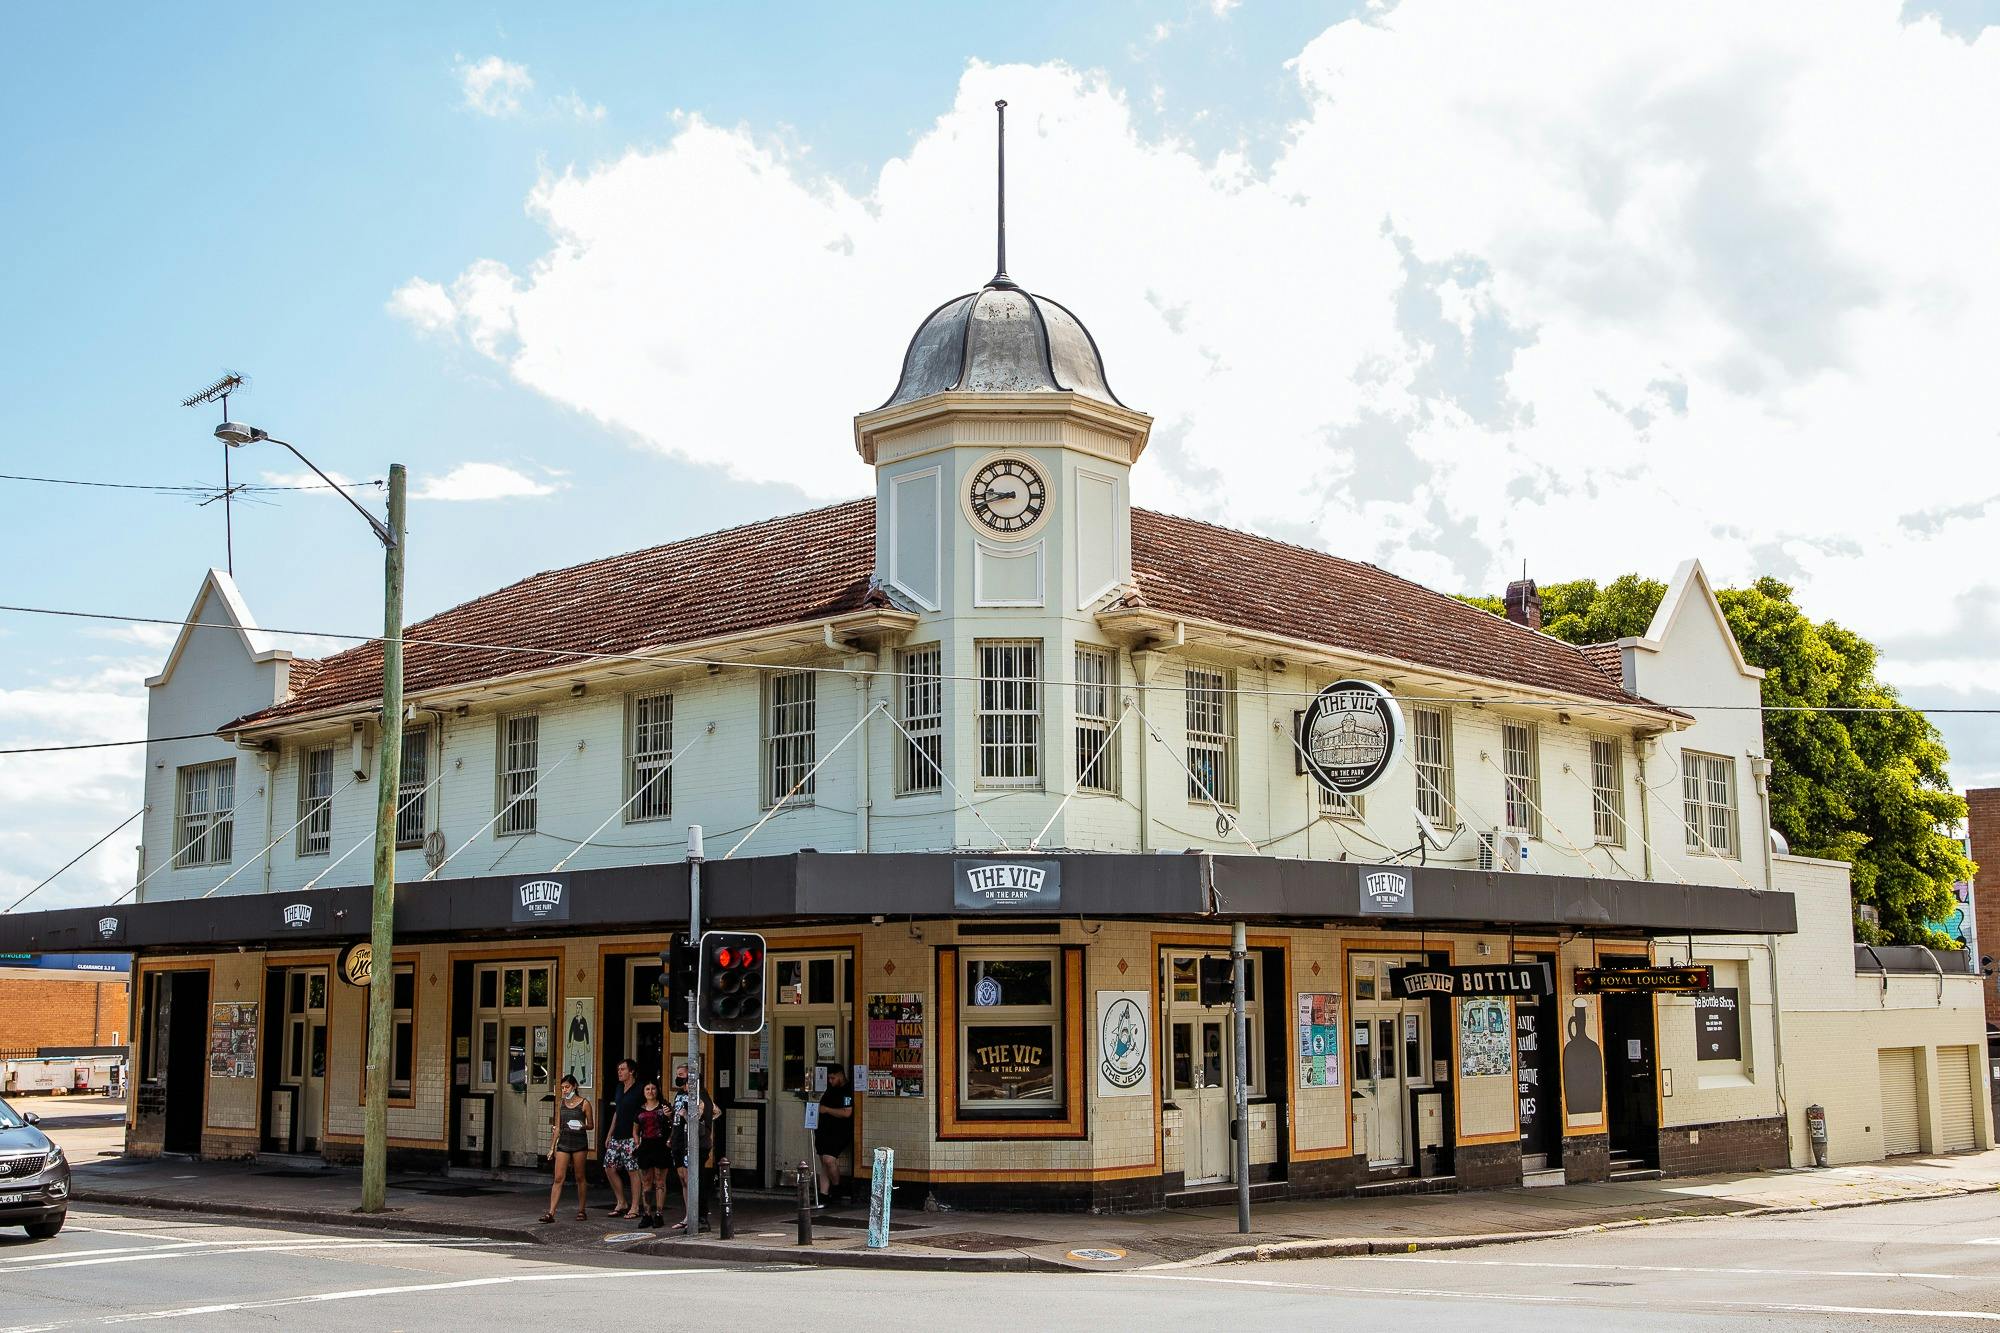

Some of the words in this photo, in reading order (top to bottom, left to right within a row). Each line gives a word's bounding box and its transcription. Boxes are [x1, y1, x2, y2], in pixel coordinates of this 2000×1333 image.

[1320, 693, 1346, 714] THE
[1349, 692, 1375, 711] VIC
[970, 868, 1005, 889] THE
[1009, 867, 1040, 889] VIC
[1367, 874, 1387, 894] THE
[1387, 875, 1404, 895] VIC
[522, 883, 541, 904] THE
[542, 882, 560, 902] VIC
[285, 906, 298, 921] THE
[298, 905, 311, 920] VIC
[100, 918, 108, 931] THE
[1405, 974, 1429, 992] THE
[1429, 974, 1451, 990] VIC
[1461, 971, 1531, 991] BOTTLO
[1600, 976, 1633, 985] ROYAL
[1637, 975, 1680, 985] LOUNGE
[1701, 995, 1719, 1008] Bottle
[895, 1023, 924, 1036] EAGLES
[1517, 1015, 1535, 1032] ANIC
[1517, 1032, 1538, 1051] NAMIC
[976, 1044, 1010, 1066] THE
[1012, 1044, 1042, 1065] VIC
[1105, 1064, 1120, 1083] THE
[1122, 1066, 1143, 1084] JETS
[869, 1079, 878, 1089] BOB
[879, 1079, 894, 1090] DYLAN
